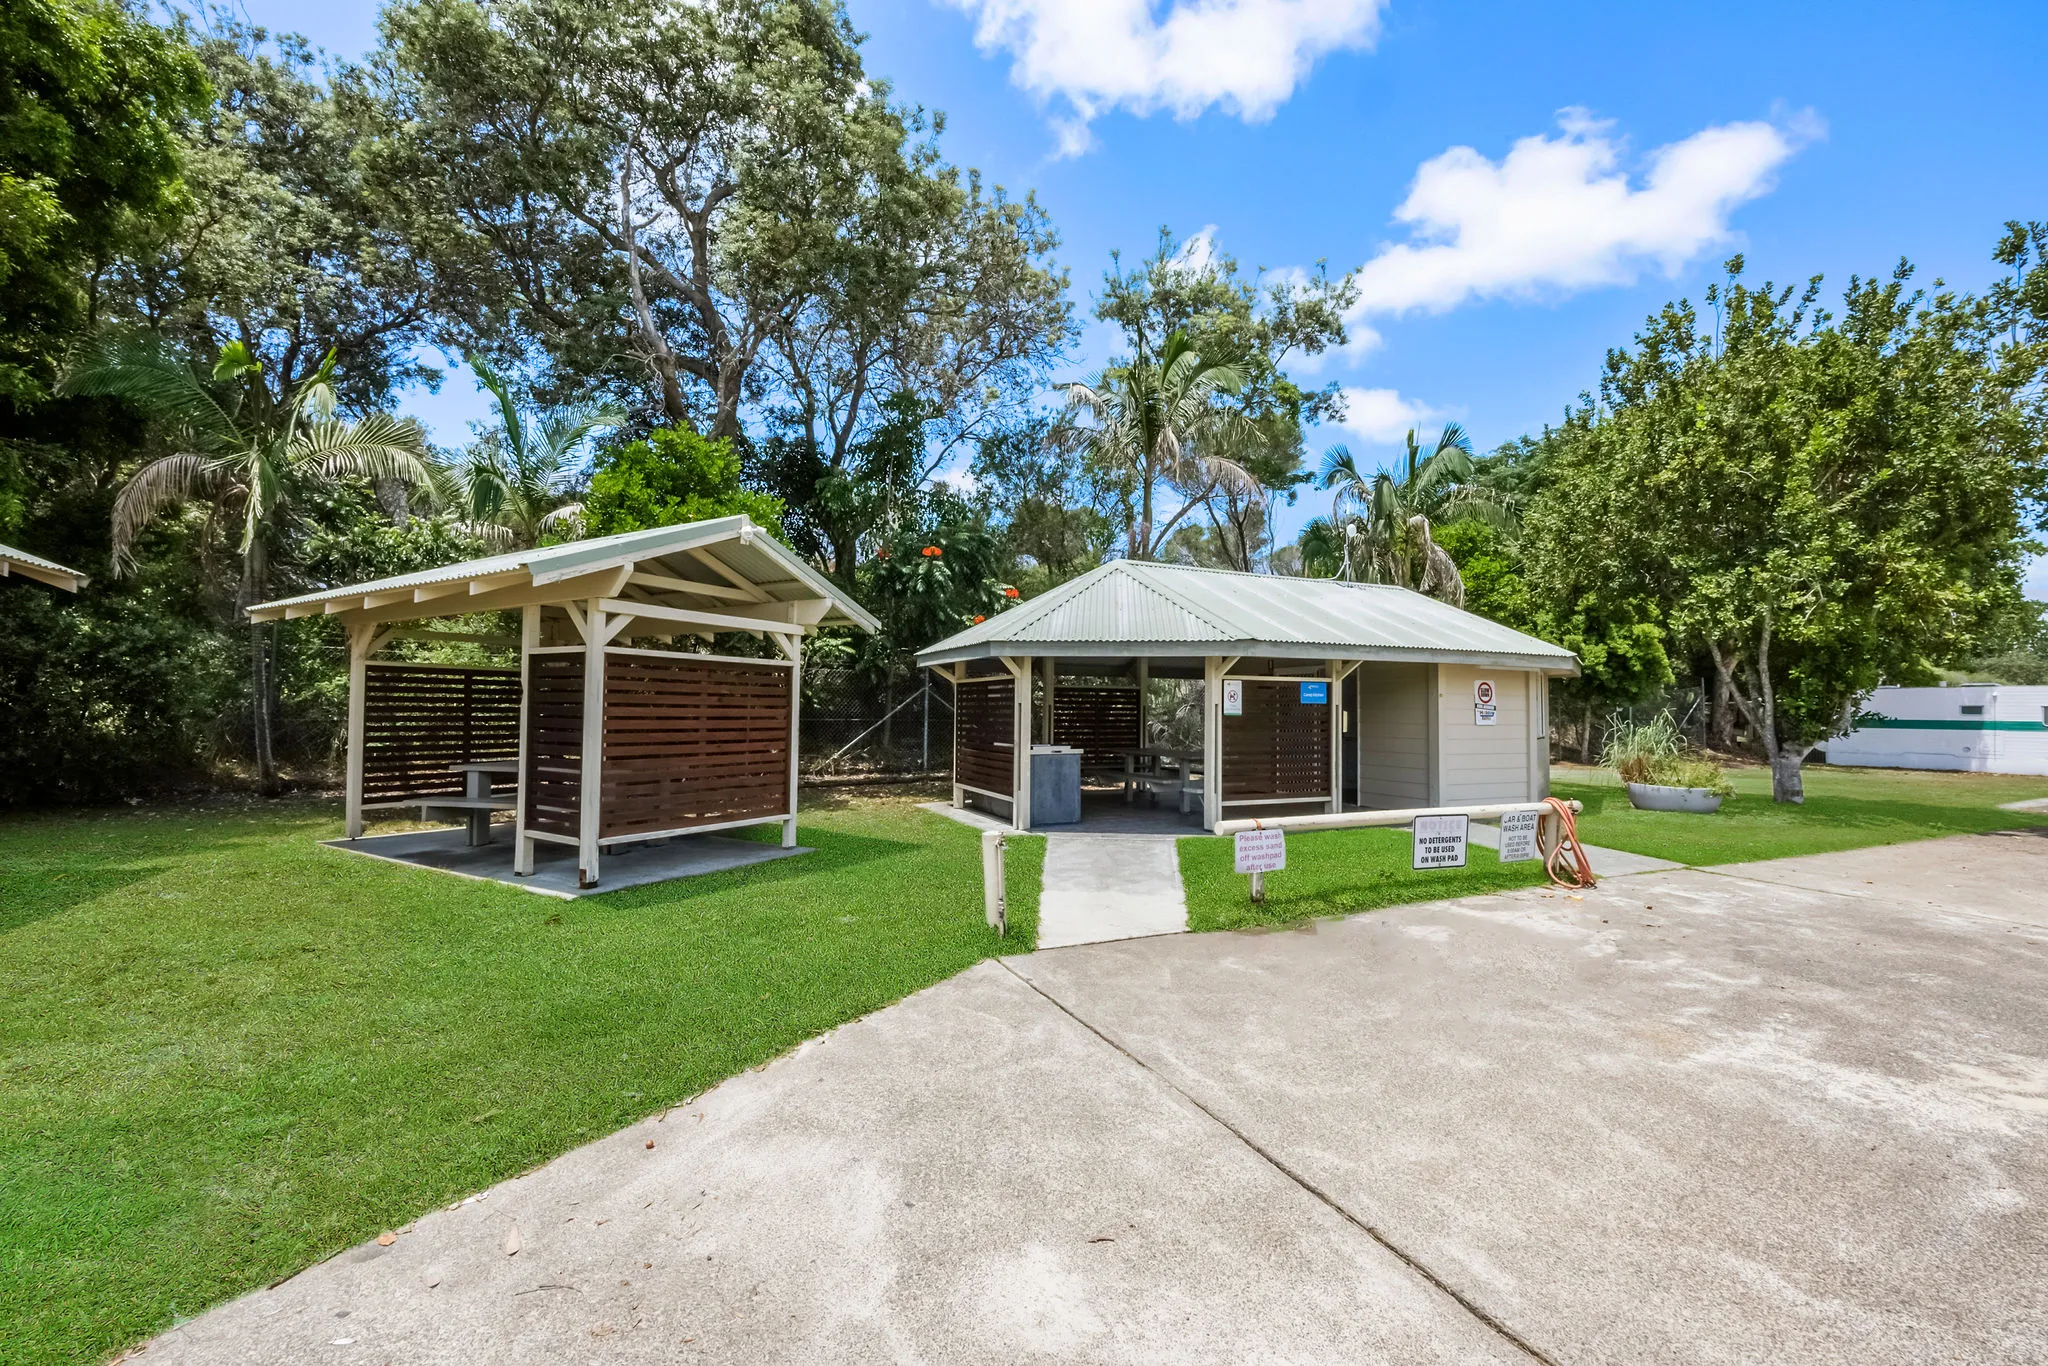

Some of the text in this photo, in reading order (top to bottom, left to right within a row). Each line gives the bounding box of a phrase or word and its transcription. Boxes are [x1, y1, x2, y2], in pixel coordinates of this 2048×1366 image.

[1522, 814, 1536, 822] BOAT
[1428, 836, 1462, 844] DETERGENTS
[1266, 842, 1282, 850] sand
[1252, 851, 1282, 860] washpad
